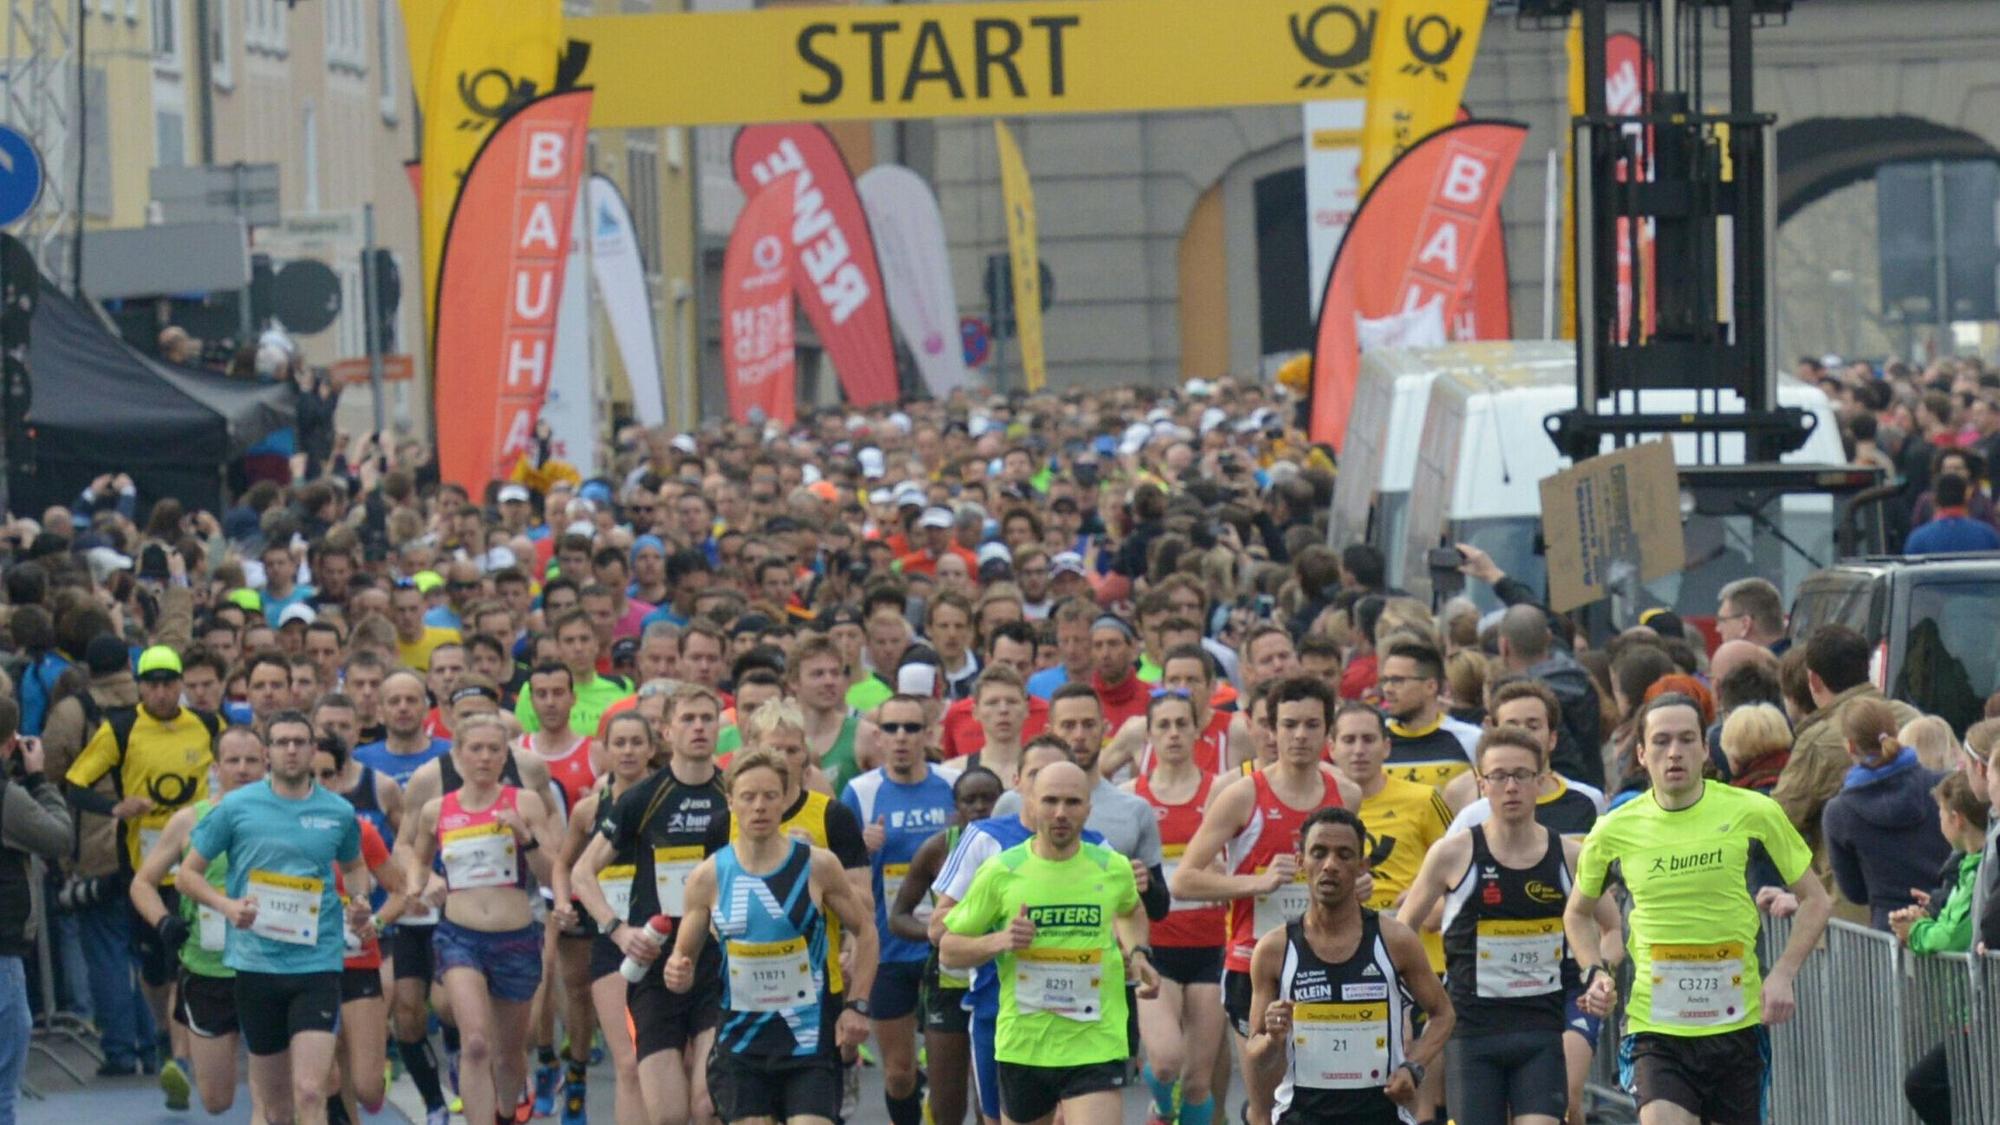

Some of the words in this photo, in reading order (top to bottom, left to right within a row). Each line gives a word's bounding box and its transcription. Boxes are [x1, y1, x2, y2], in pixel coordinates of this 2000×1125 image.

[795, 15, 1080, 105] START
[1670, 848, 1722, 871] bunert
[1030, 907, 1099, 925] PETERS
[1511, 952, 1539, 963] 4795
[753, 970, 785, 981] 11871
[1045, 978, 1074, 990] 8291
[1679, 978, 1719, 990] C3273
[1333, 1039, 1348, 1051] 21
